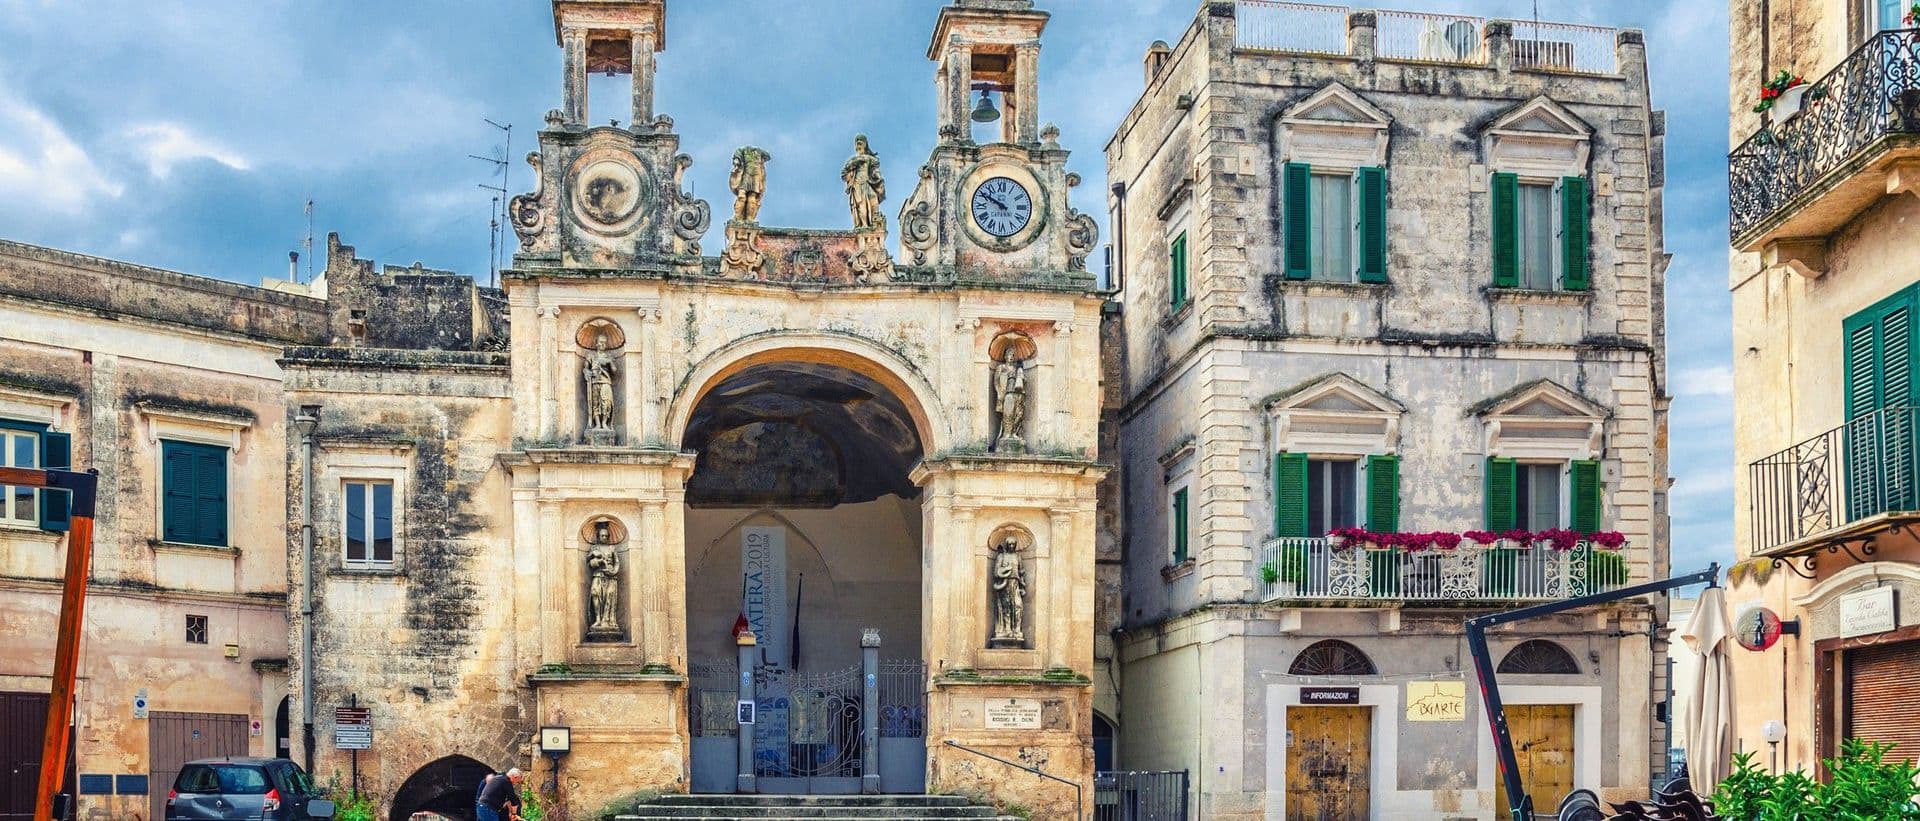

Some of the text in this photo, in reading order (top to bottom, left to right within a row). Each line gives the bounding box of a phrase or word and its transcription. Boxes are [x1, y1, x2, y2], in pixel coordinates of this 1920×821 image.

[747, 533, 763, 645] MATERA 2019
[1856, 598, 1876, 611] Bar
[1310, 691, 1349, 700] INFORMAZIONI
[1419, 701, 1462, 716] BGARTE
